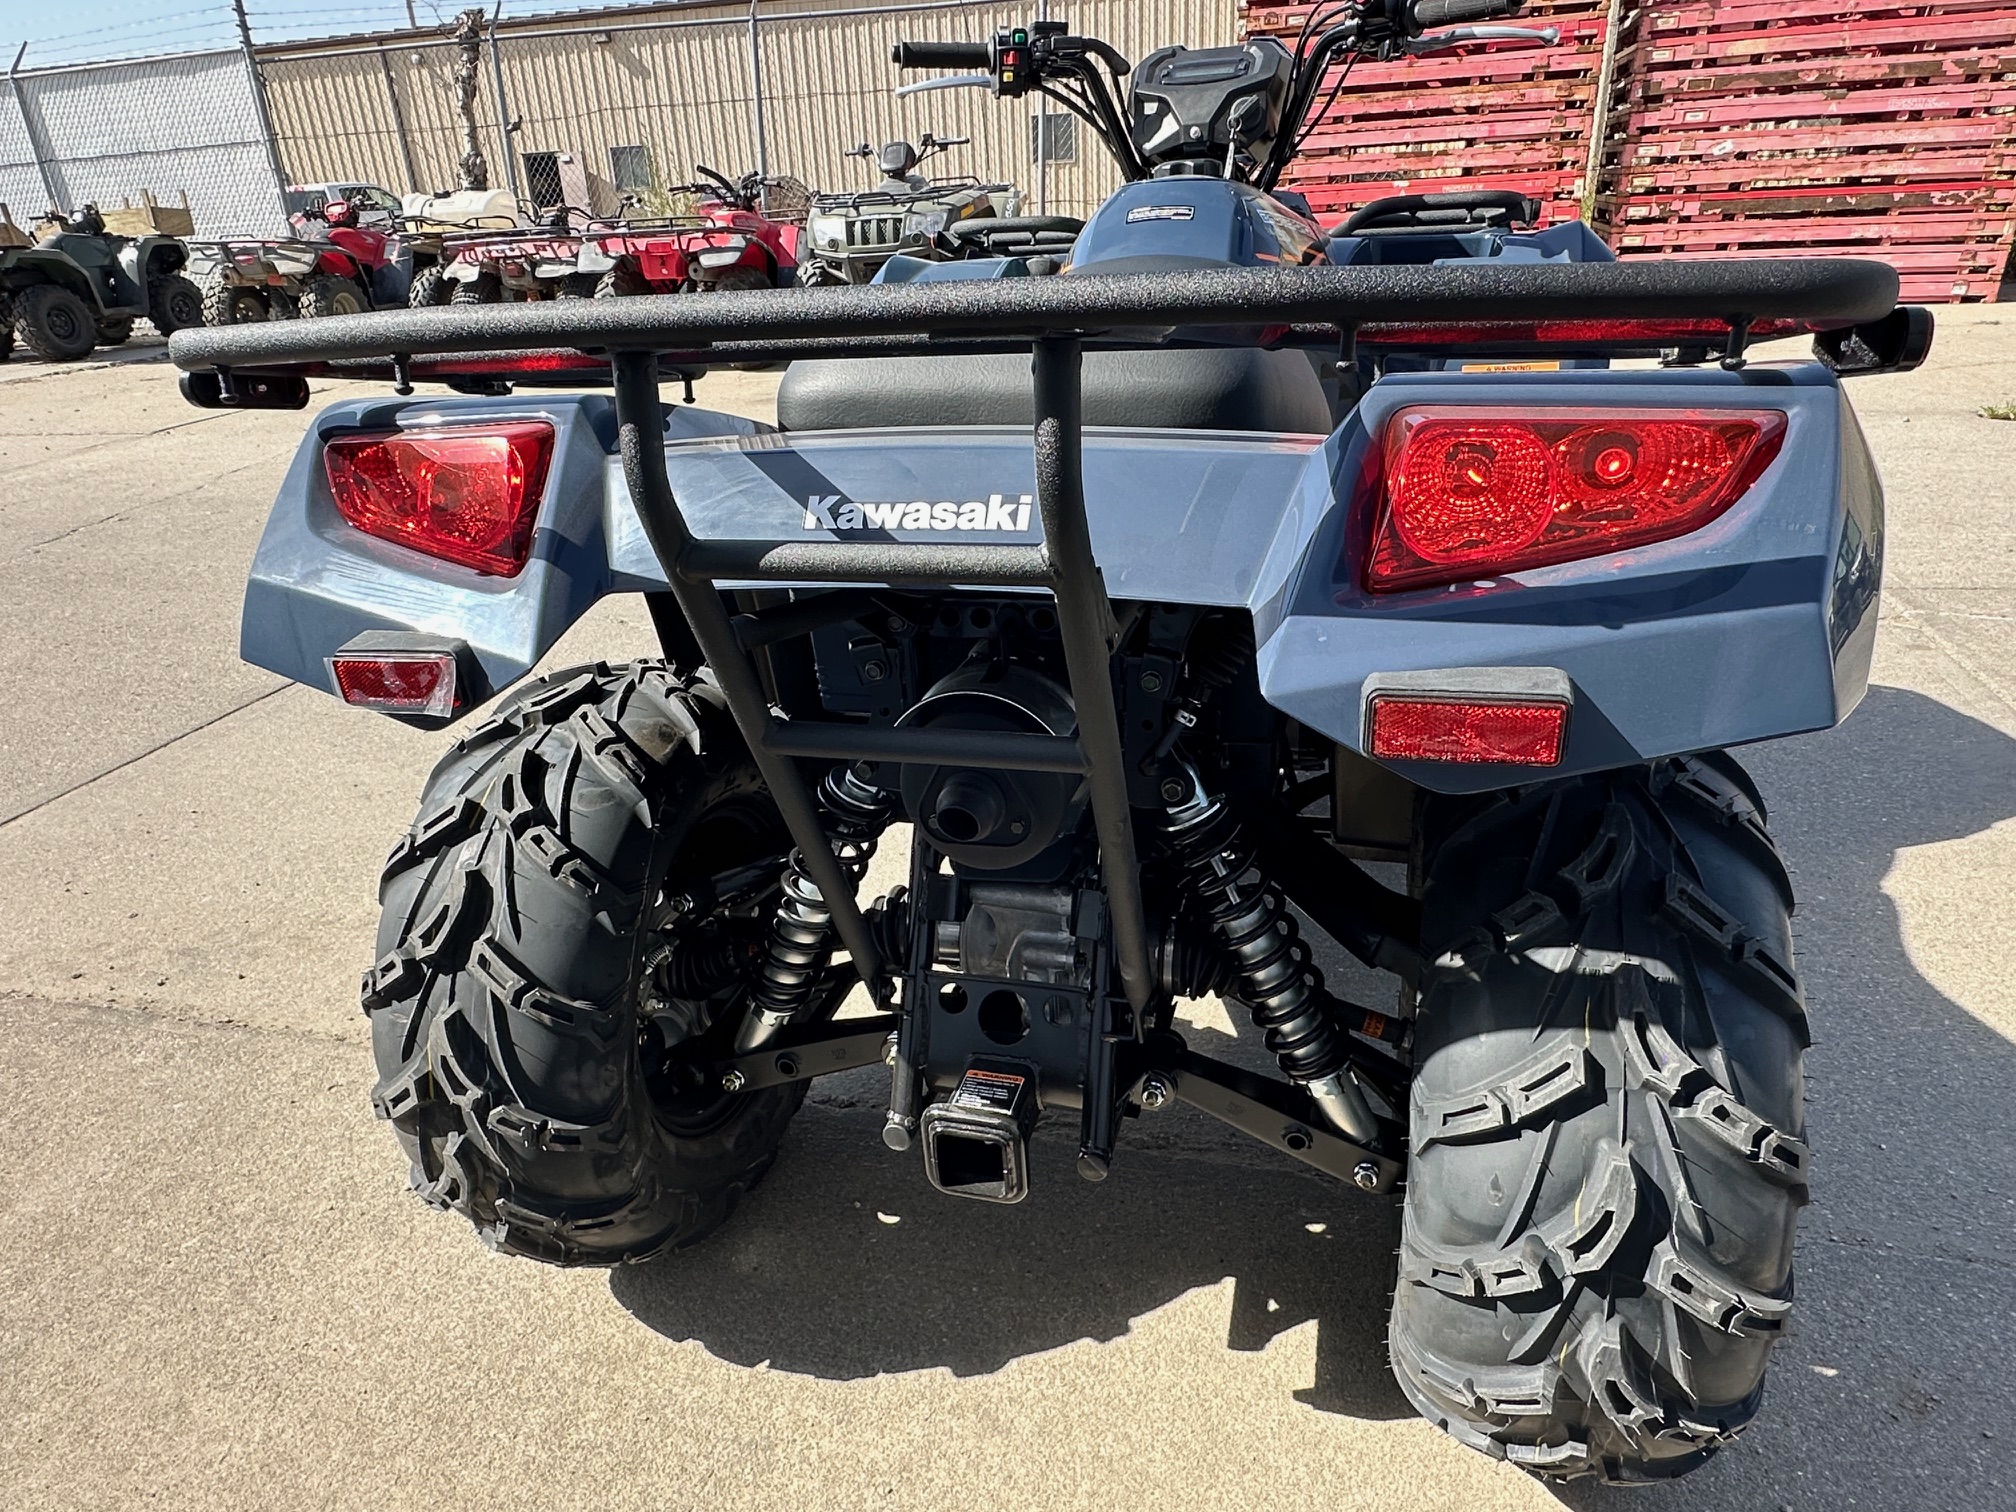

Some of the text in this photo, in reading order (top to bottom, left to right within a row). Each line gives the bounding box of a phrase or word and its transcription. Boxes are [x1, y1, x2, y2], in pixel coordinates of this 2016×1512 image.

[1827, 102, 1838, 112] A
[1821, 136, 1831, 145] A
[803, 493, 1034, 532] Kawasaki
[982, 1073, 1019, 1081] WARNING
